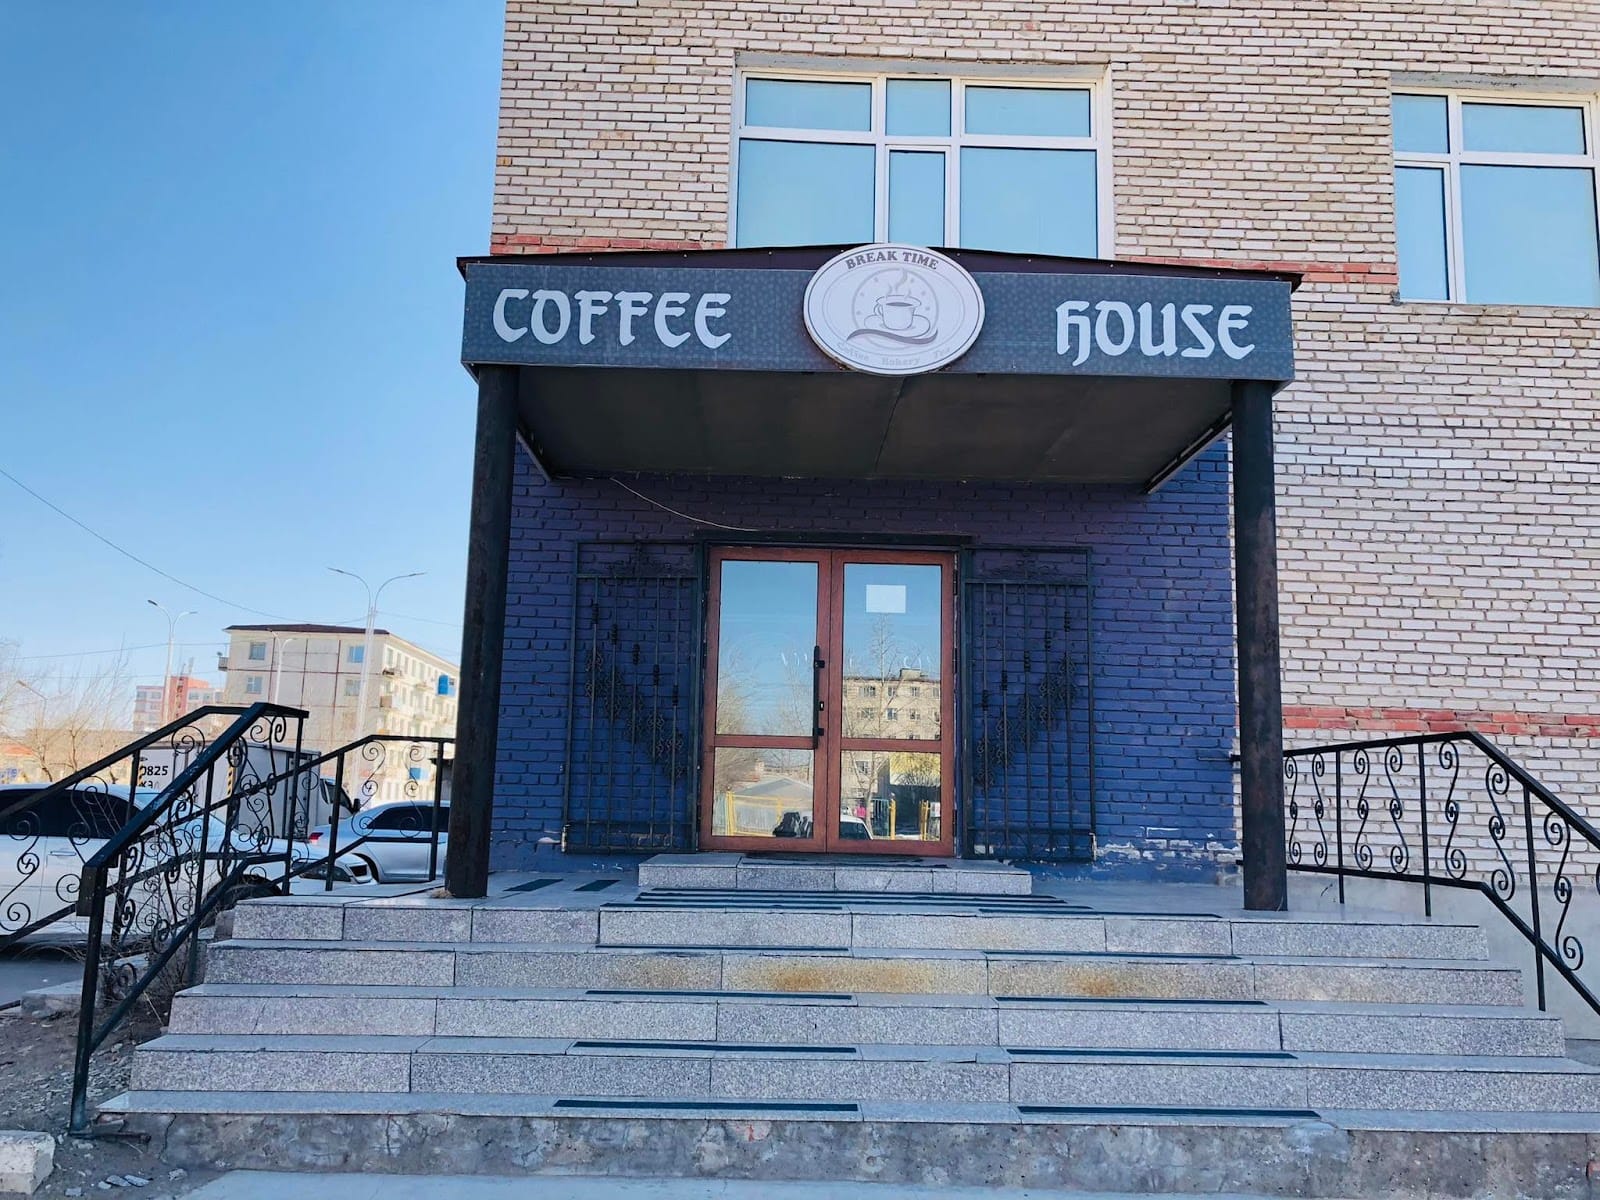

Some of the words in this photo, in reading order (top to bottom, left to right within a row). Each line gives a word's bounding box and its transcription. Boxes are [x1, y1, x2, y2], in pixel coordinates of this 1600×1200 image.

[845, 250, 898, 270] BREAK
[902, 251, 939, 270] TIME
[492, 288, 732, 349] COFFEE
[1055, 300, 1255, 367] HOUSE
